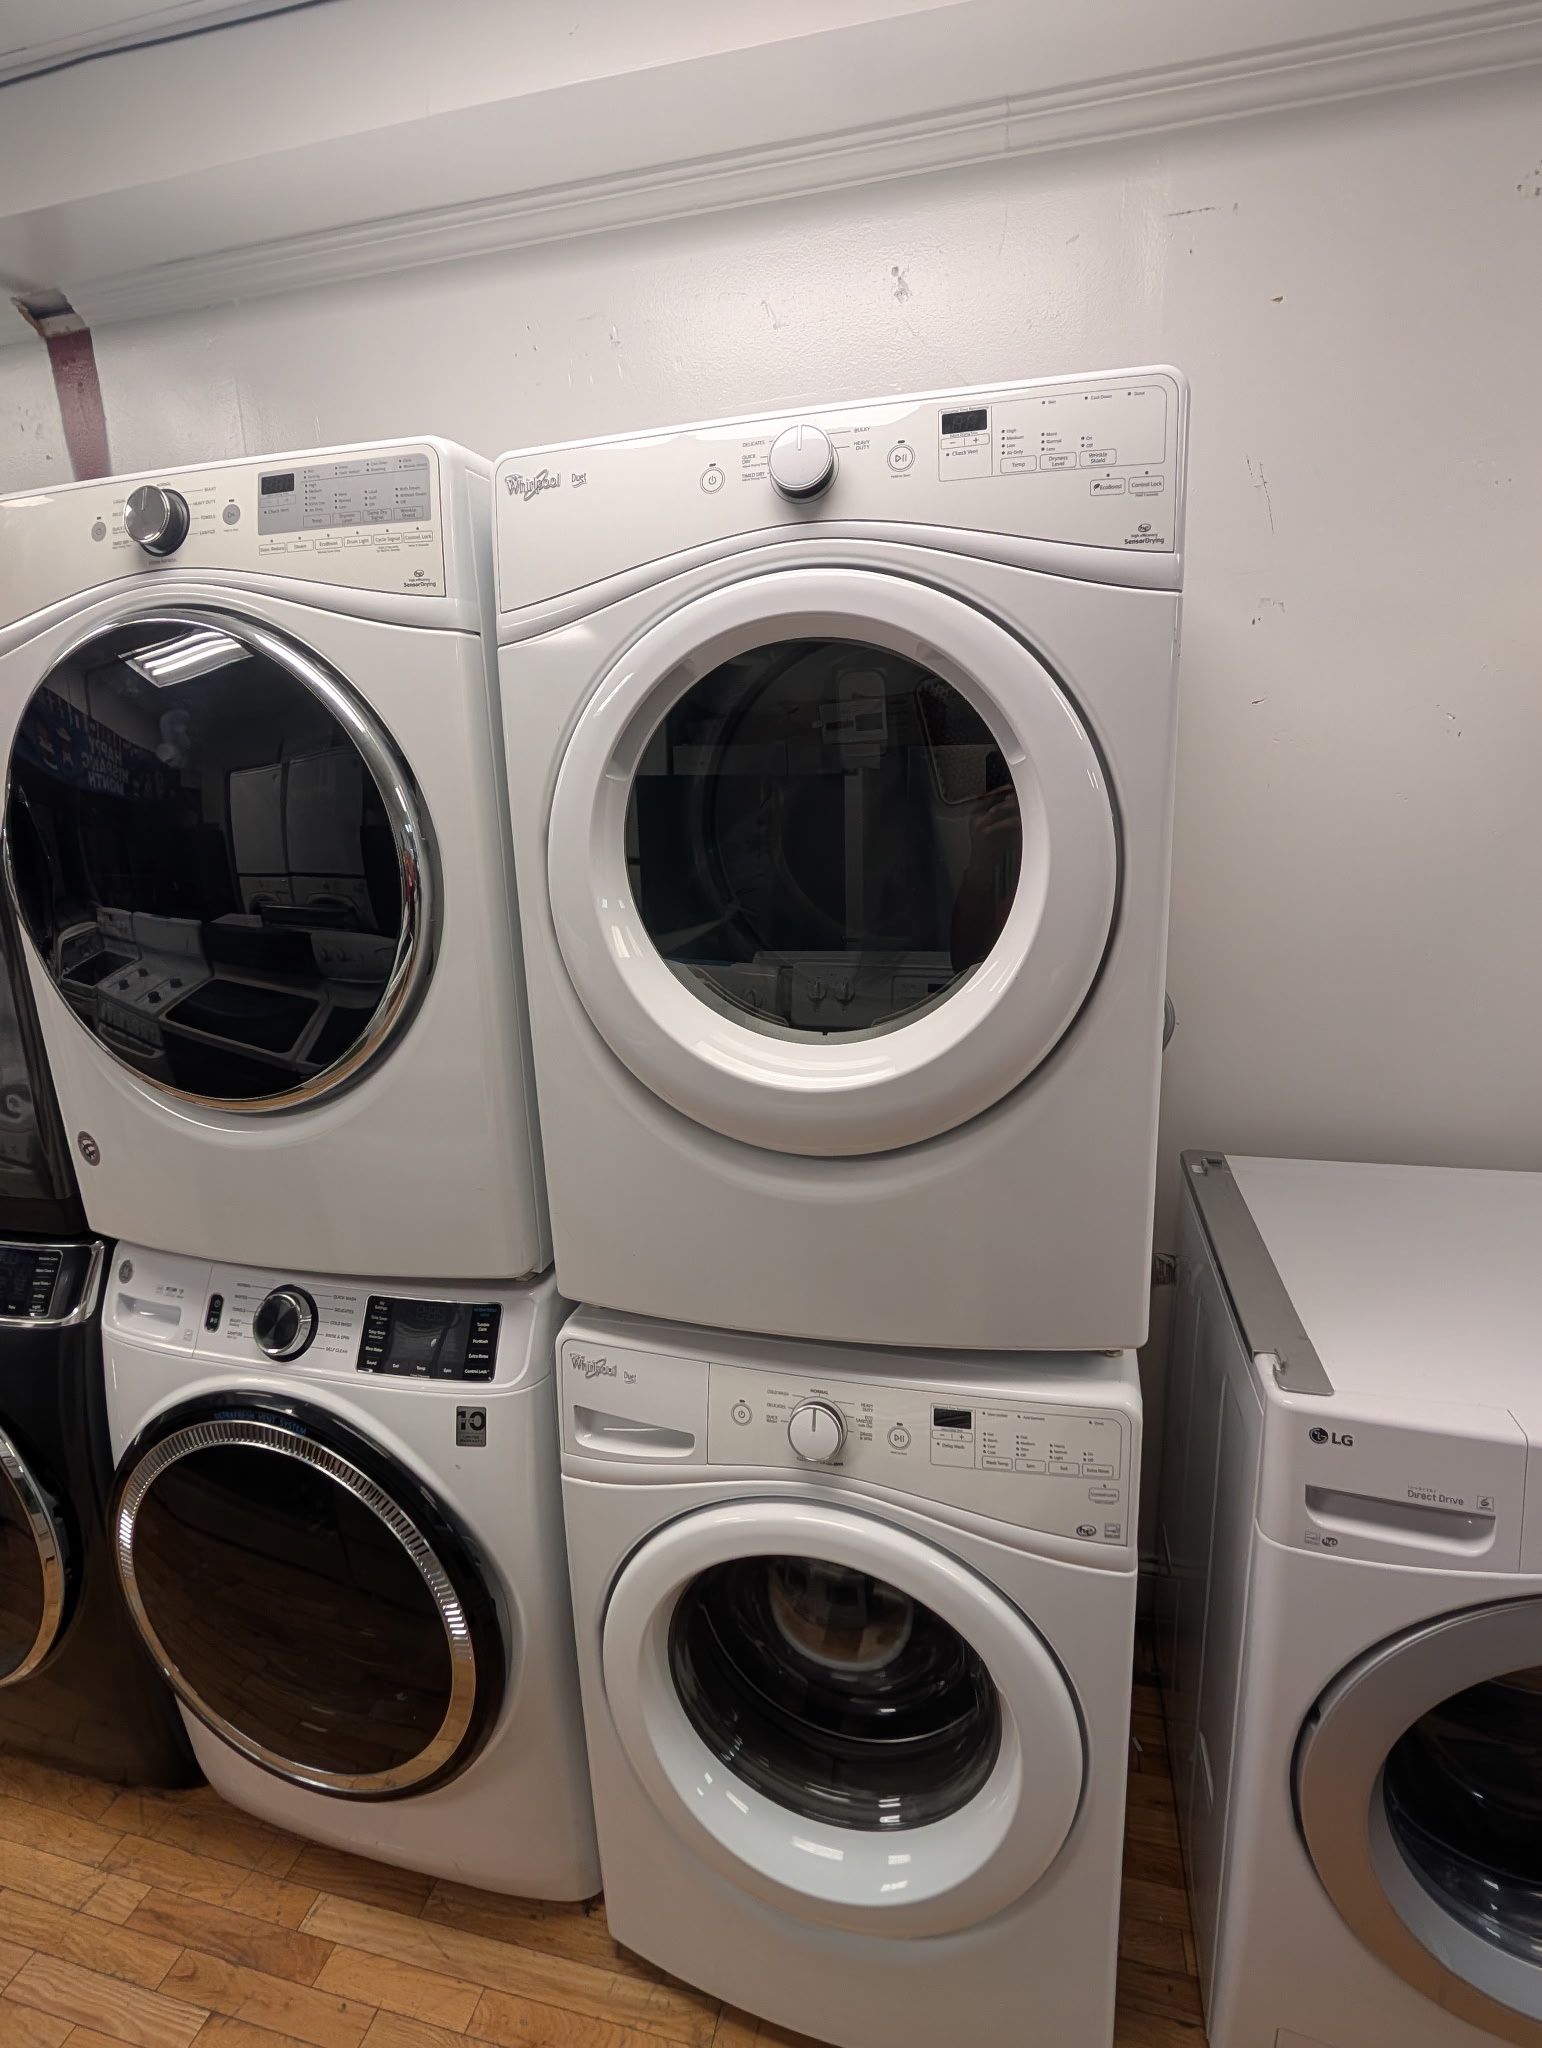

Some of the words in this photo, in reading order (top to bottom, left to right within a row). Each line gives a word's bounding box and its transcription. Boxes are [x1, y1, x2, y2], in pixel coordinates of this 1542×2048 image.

[505, 468, 561, 502] Whirlpool
[569, 1353, 617, 1379] Whirlpool
[457, 1410, 487, 1431] 10
[1331, 1432, 1354, 1447] LG
[1408, 1490, 1436, 1502] Direct
[1438, 1494, 1464, 1506] Drive
